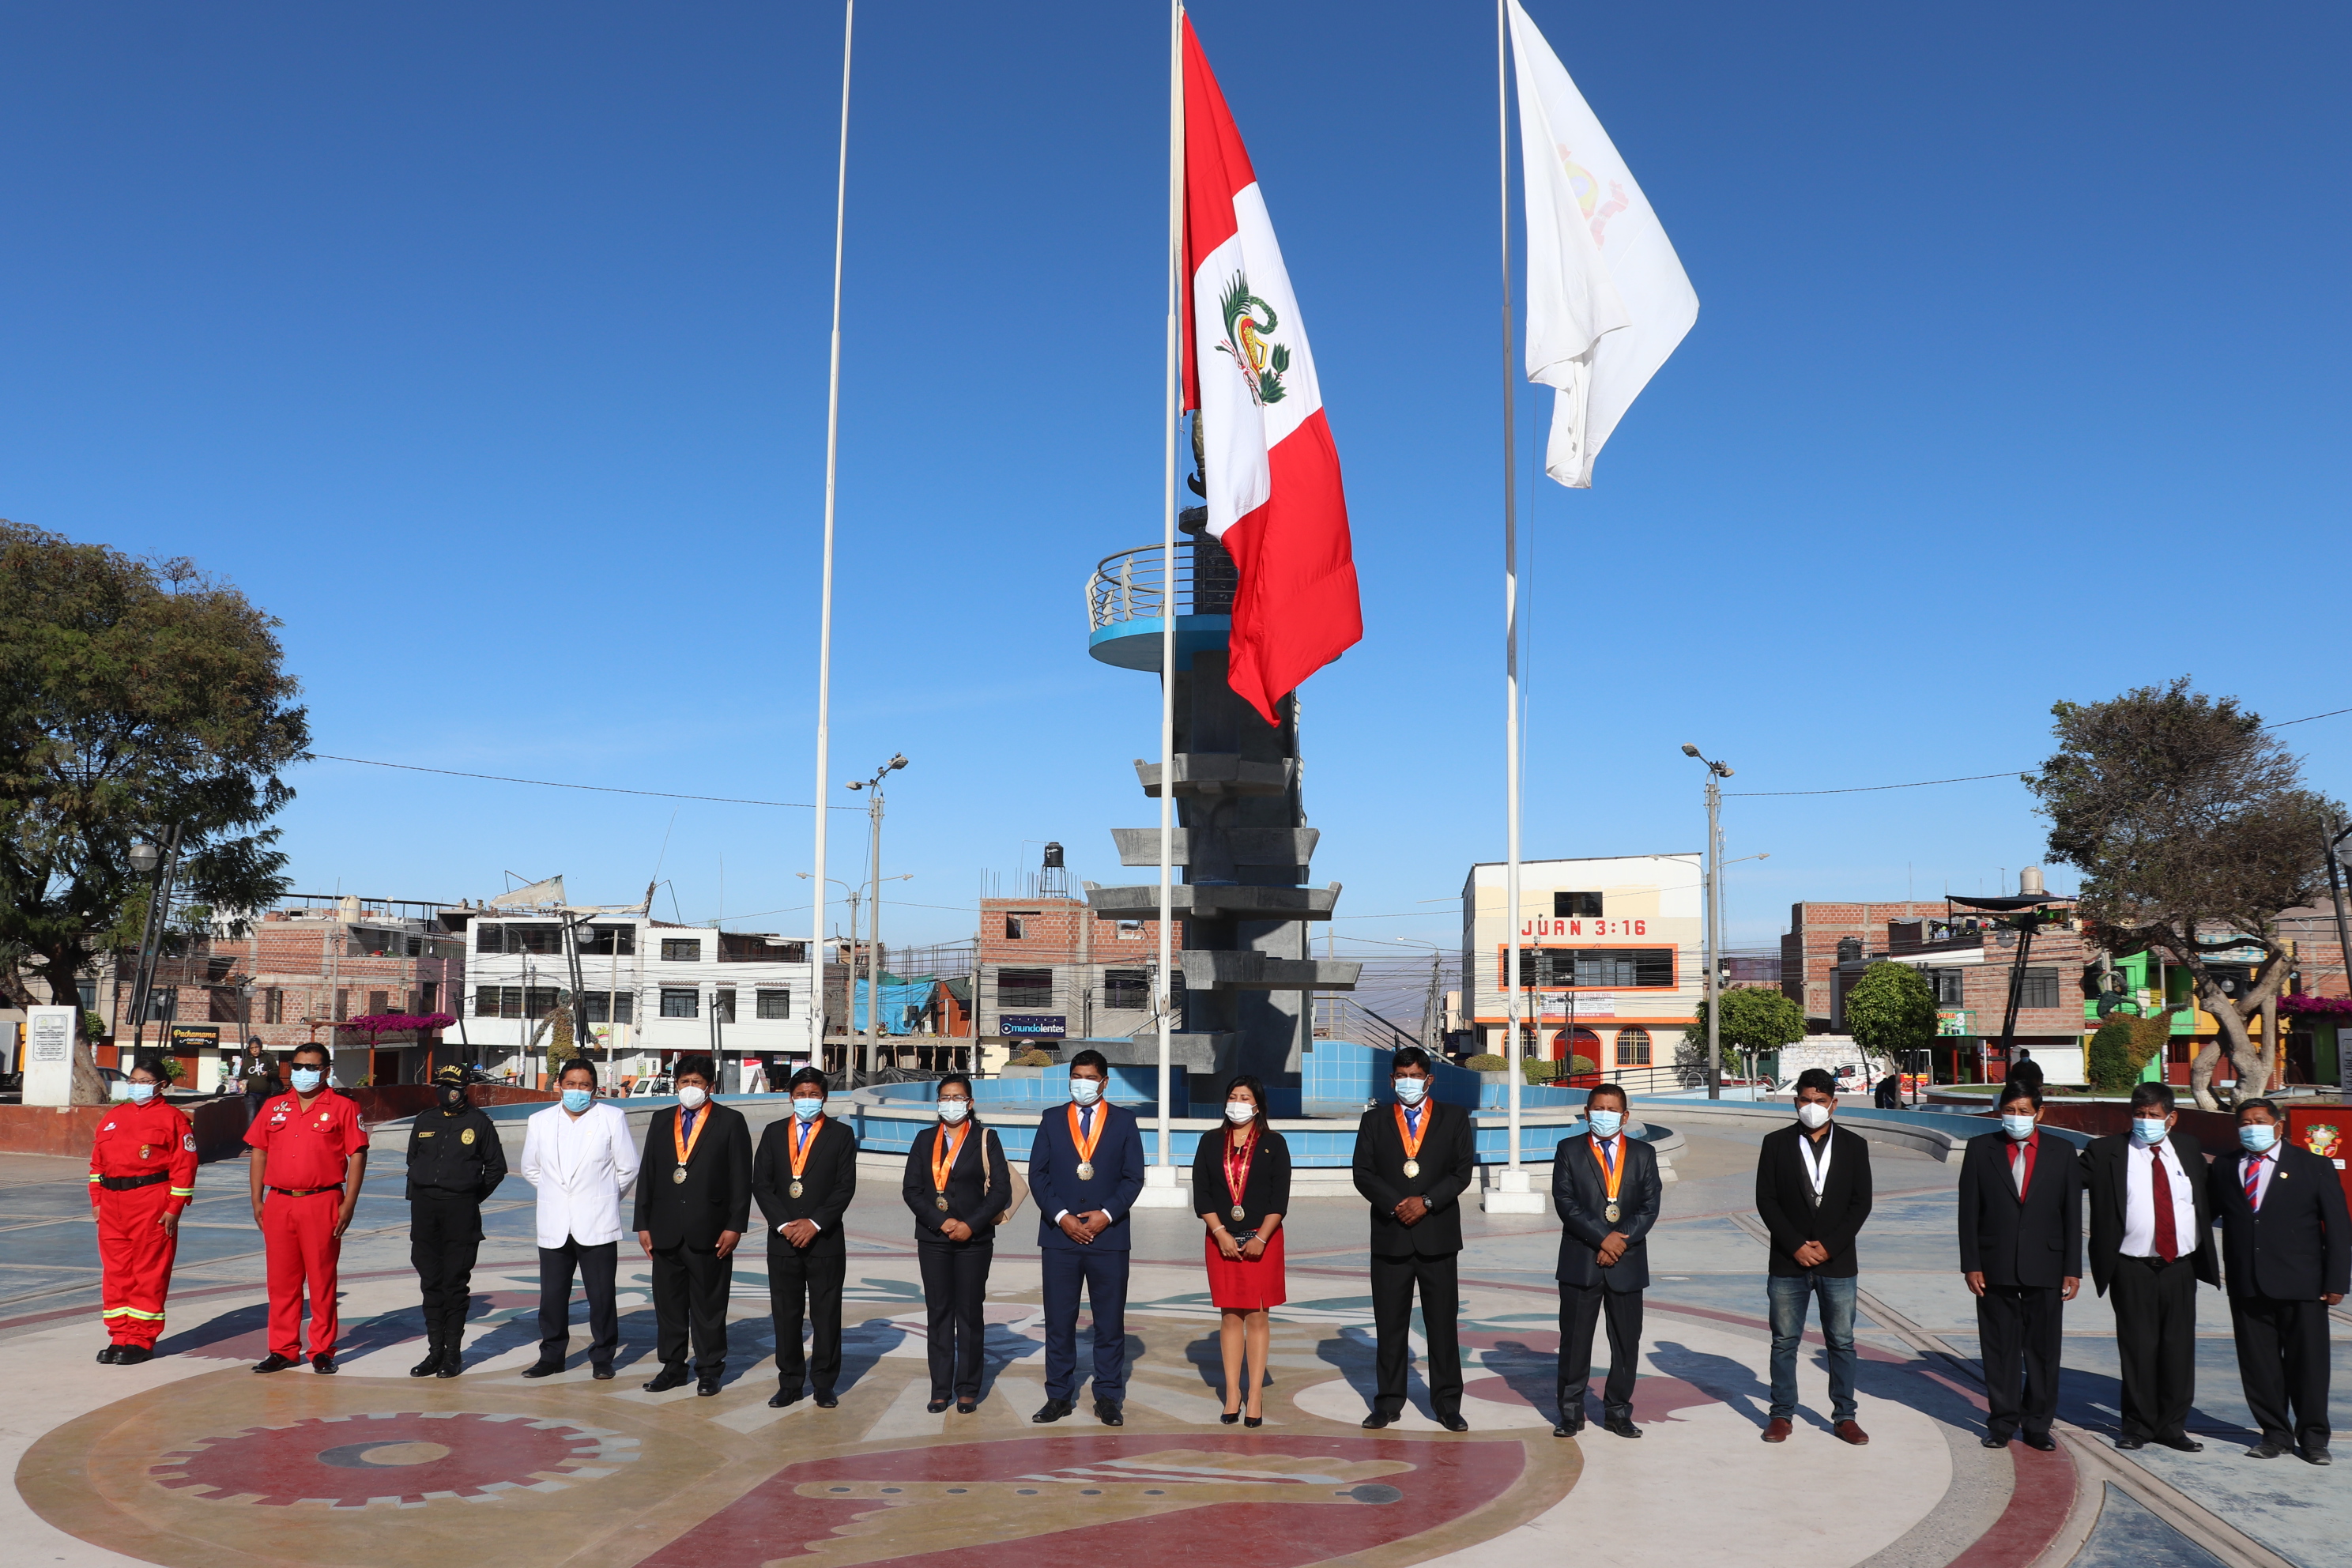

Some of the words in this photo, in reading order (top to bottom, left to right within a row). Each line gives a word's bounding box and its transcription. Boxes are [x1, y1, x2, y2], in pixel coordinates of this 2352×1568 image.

[1521, 920, 1581, 936] JUAN
[1595, 920, 1645, 936] 3:16
[1012, 1023, 1065, 1033] mundolentes
[173, 1029, 217, 1038] Pachamama
